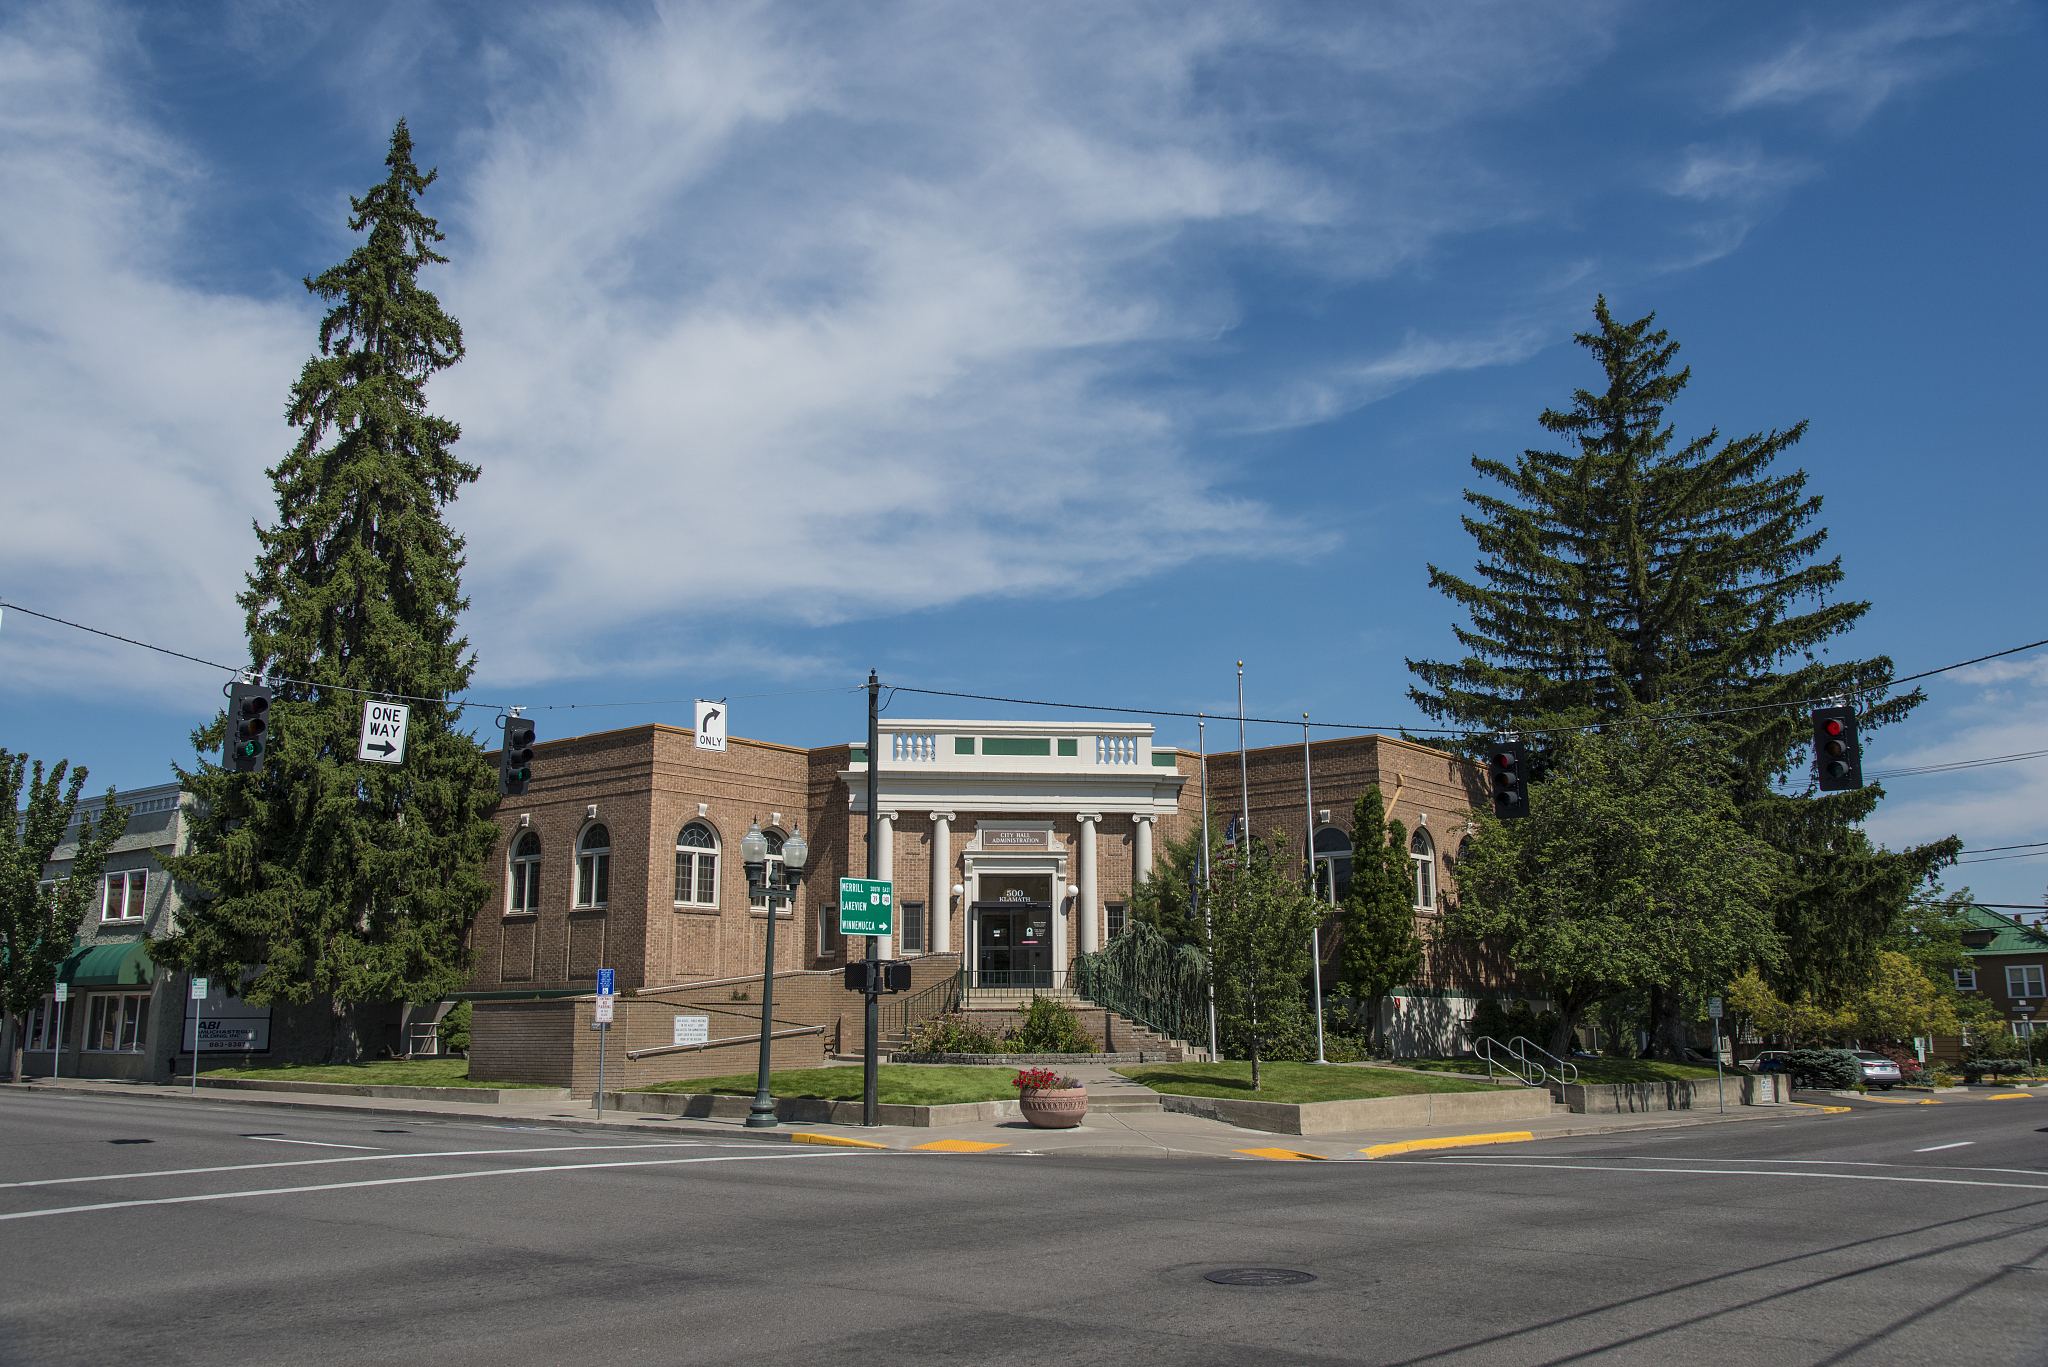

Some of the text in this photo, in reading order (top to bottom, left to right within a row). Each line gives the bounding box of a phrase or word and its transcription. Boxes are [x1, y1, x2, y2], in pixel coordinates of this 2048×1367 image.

[372, 706, 401, 723] ONE
[370, 721, 401, 738] WAY
[699, 734, 722, 747] ONLY
[842, 882, 864, 892] MERRILL
[842, 901, 867, 911] LAKEVIEW
[842, 920, 875, 930] WINNEMUCCA
[198, 1021, 222, 1029] ABI
